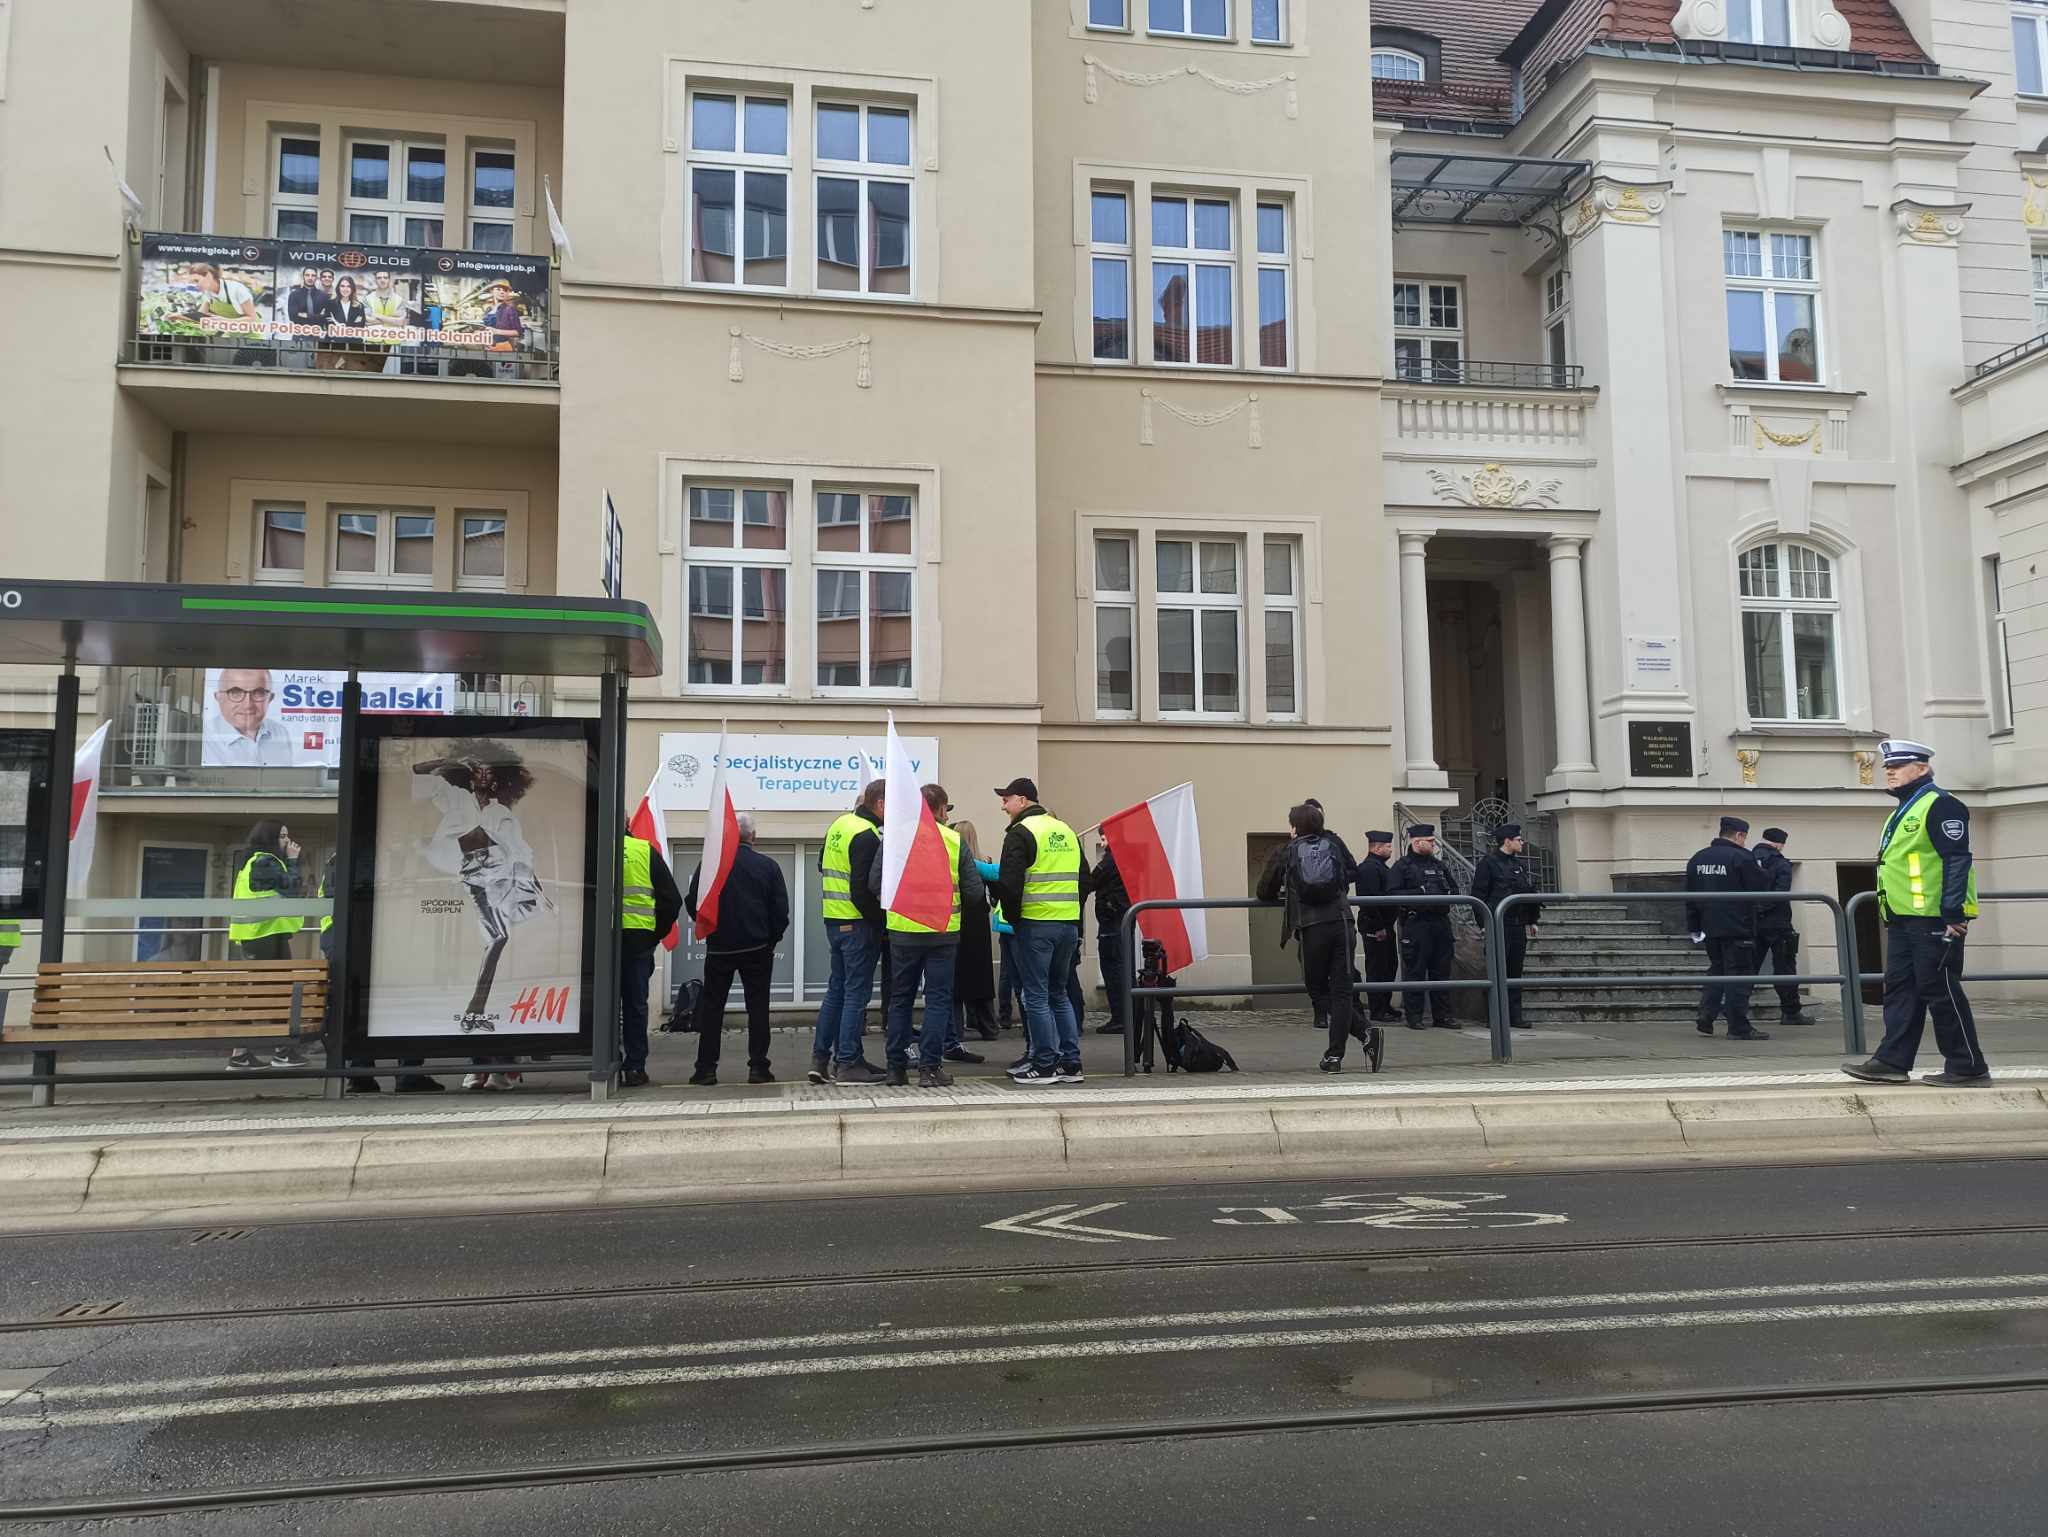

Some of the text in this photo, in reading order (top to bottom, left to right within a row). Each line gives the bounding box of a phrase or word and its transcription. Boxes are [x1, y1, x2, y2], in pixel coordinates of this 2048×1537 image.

[158, 244, 240, 258] www.workglob.pl
[289, 251, 411, 267] WORK GLOB
[457, 260, 536, 274] info@workglob.pl
[201, 317, 494, 345] Praca w Polsce, Niemczech i Holandii
[283, 674, 324, 684] Marek
[848, 755, 921, 773] Gbiy
[756, 776, 858, 794] Terapeutycz
[1696, 864, 1727, 876] POLICJA
[444, 906, 462, 914] PLN
[510, 985, 571, 1026] H&M
